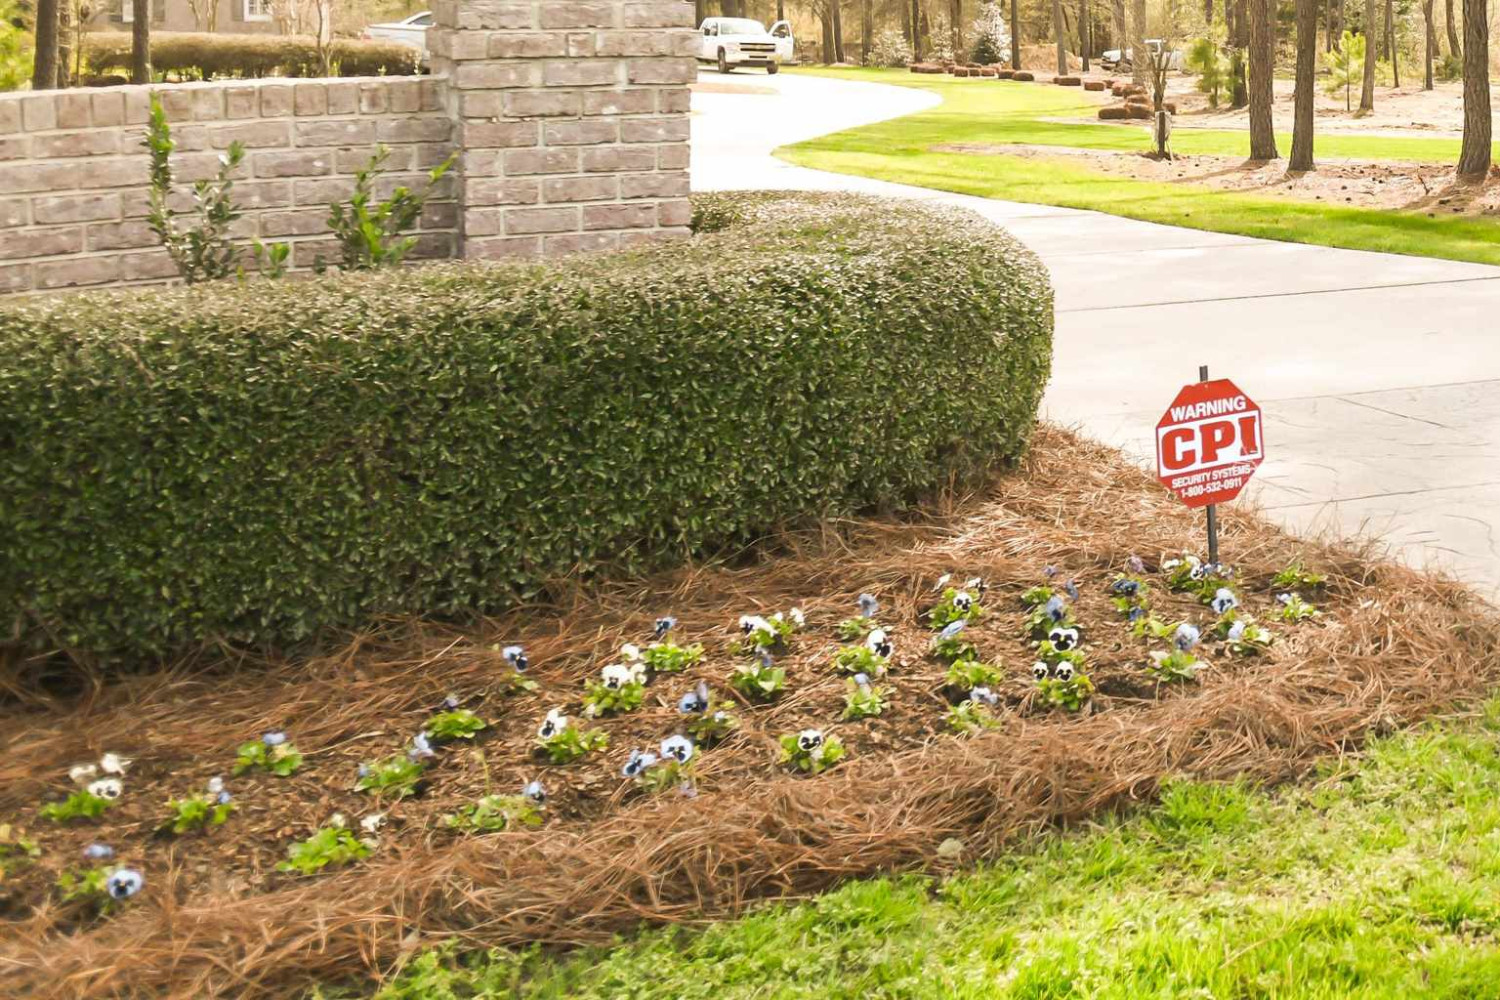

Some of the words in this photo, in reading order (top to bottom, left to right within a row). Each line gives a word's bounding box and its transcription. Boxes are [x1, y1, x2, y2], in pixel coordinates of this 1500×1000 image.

[1171, 395, 1246, 422] WARNING
[1162, 416, 1258, 470] CPI
[1172, 471, 1211, 488] SECURITY
[1212, 464, 1250, 480] SYSTEMS
[1181, 477, 1242, 498] 1-800-532-0911
